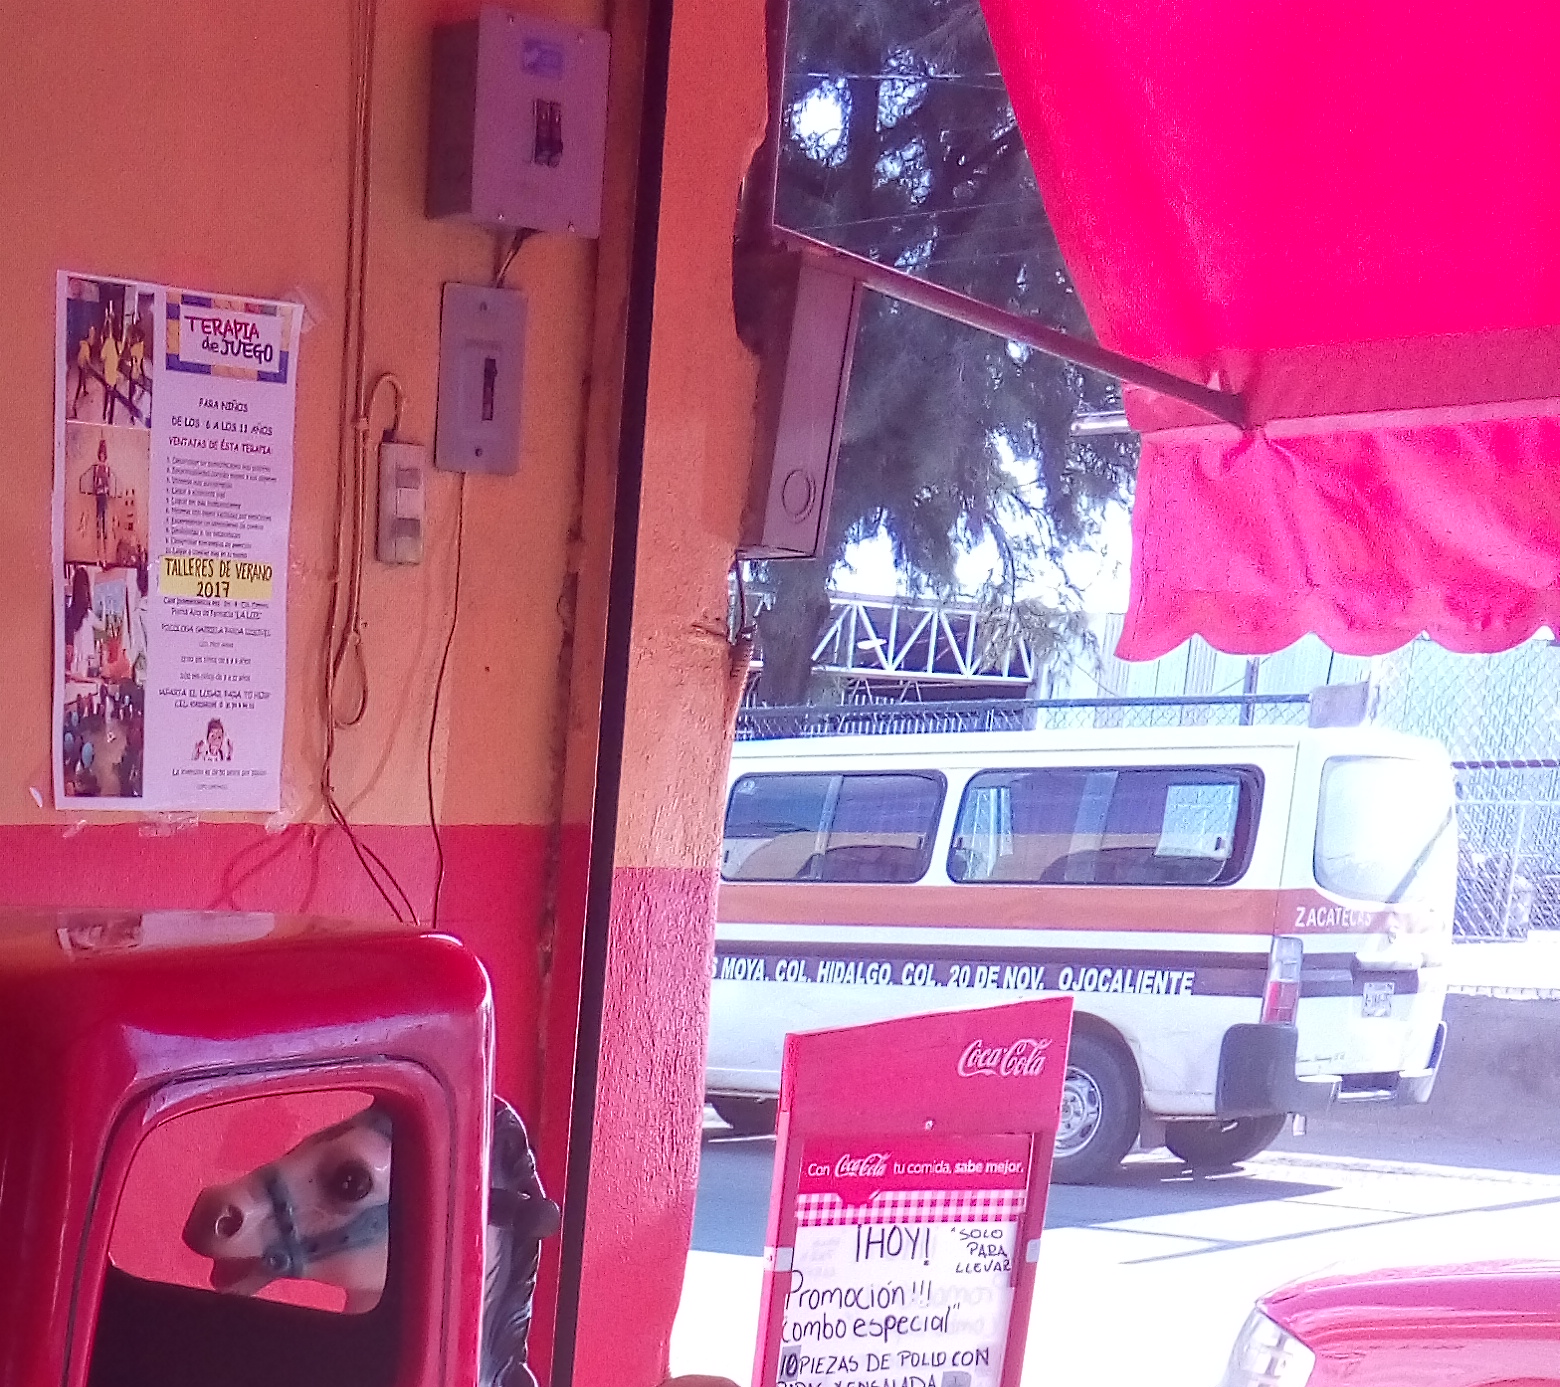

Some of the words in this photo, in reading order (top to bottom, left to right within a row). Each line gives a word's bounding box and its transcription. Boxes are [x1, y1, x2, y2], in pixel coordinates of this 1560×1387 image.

[184, 315, 260, 342] TERAPIA
[202, 336, 218, 352] de
[220, 339, 273, 364] JUEGO
[172, 416, 182, 427] DE
[185, 417, 200, 428] LOS
[221, 421, 237, 432] LOS
[165, 557, 214, 578] TALLERES
[220, 559, 231, 578] DE
[235, 562, 273, 583] VERANO
[196, 581, 231, 598] 2017
[1294, 906, 1372, 928] ZACATECAS
[947, 964, 970, 988] 20
[974, 964, 1000, 989] DE
[1058, 966, 1195, 995] OJOCALIENTE
[807, 1162, 831, 1177] Con
[893, 1162, 907, 1174] tu
[954, 1159, 983, 1174] sabe
[966, 1241, 1008, 1258] PARA
[955, 1259, 1012, 1274] LLEVAR
[799, 1354, 859, 1375] PIEZAS
[866, 1352, 891, 1373] DE
[897, 1349, 947, 1372] POLLO
[951, 1346, 990, 1367] CON
